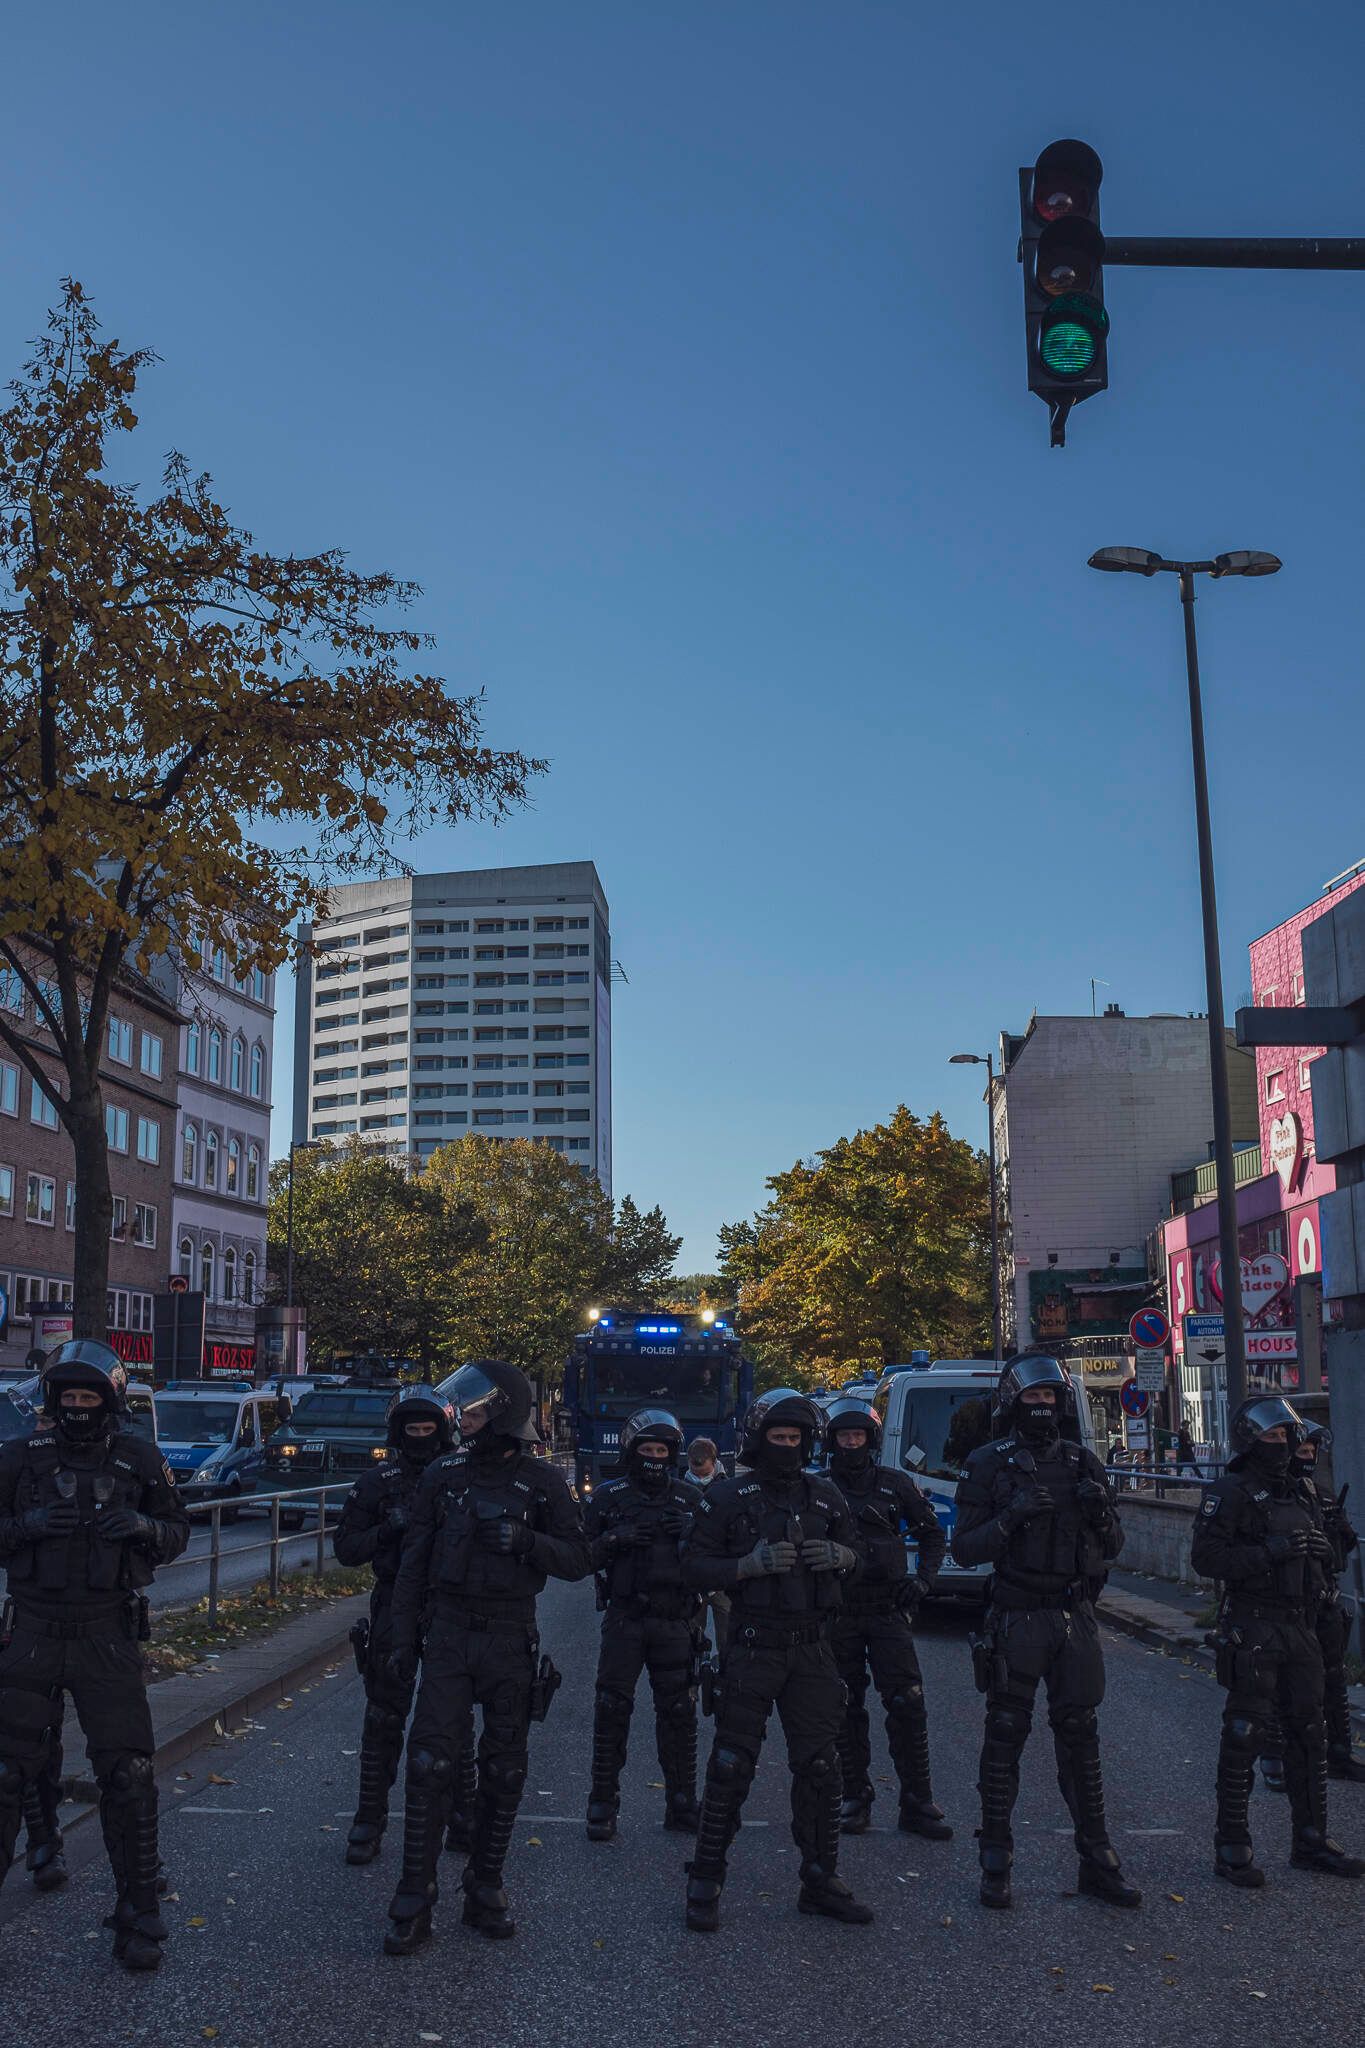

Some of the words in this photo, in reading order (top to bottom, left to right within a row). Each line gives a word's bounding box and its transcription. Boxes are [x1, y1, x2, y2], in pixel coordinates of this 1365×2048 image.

[1238, 1264, 1272, 1276] ink
[1248, 1337, 1297, 1352] HOUS
[212, 1343, 238, 1368] KÖZ
[640, 1345, 677, 1356] POLIZEI
[65, 1411, 89, 1422] POLIZEI
[28, 1437, 57, 1447] POLIZEI
[441, 1457, 467, 1468] POLIZEI
